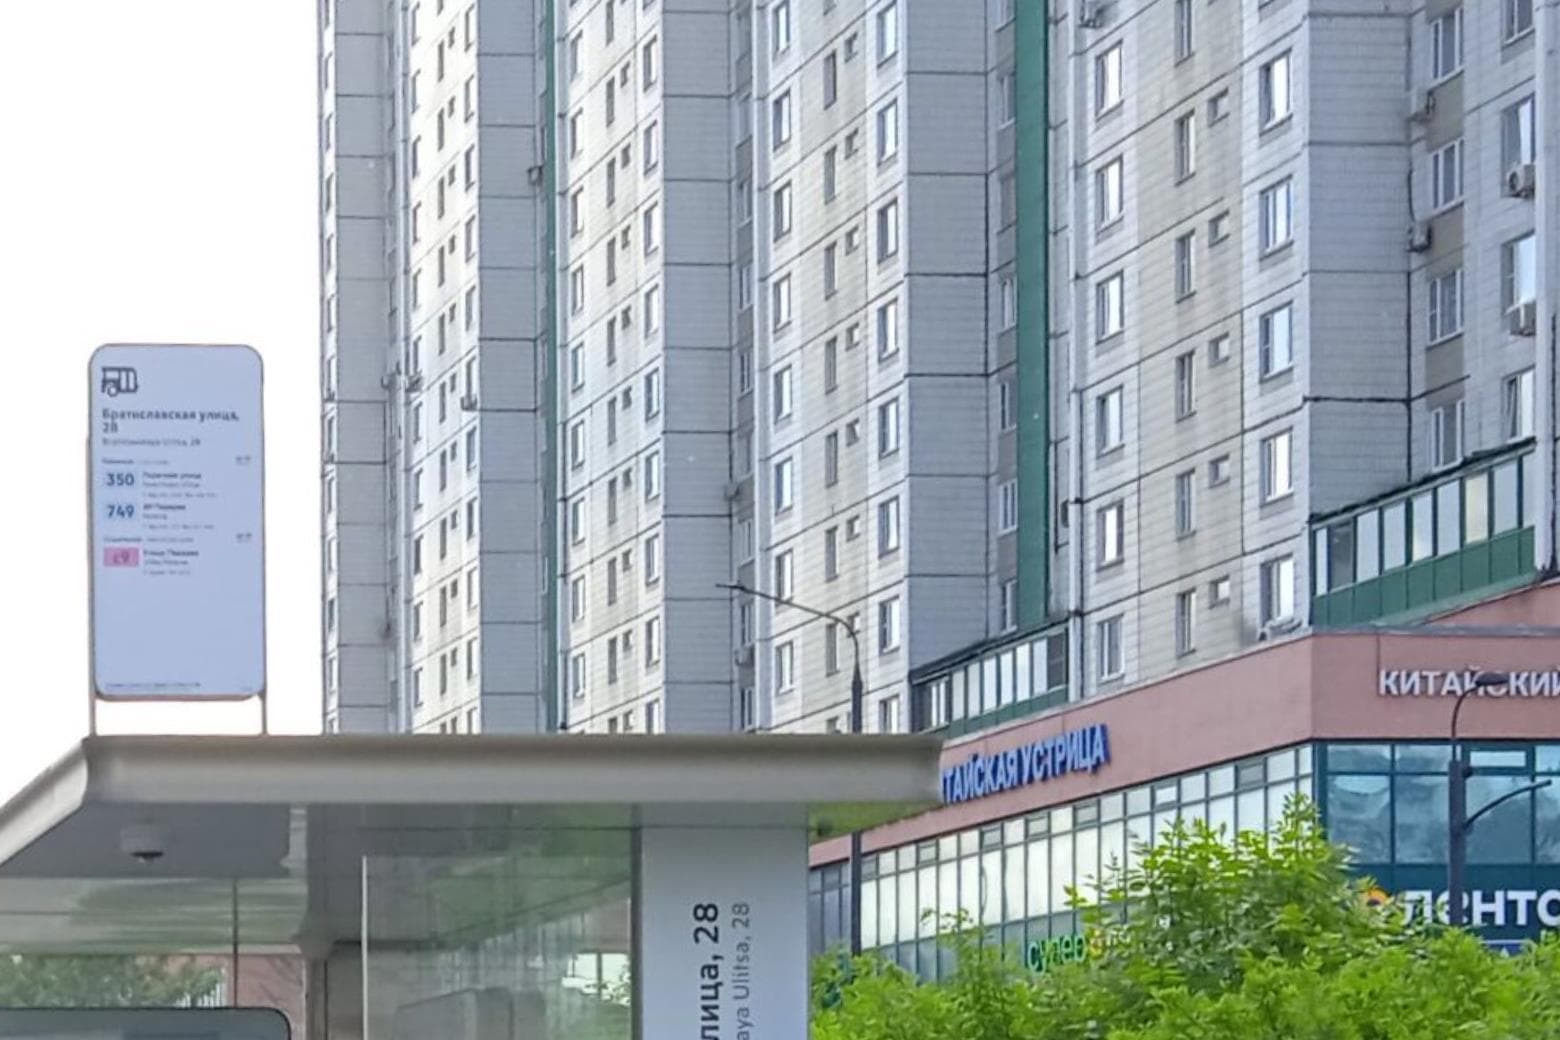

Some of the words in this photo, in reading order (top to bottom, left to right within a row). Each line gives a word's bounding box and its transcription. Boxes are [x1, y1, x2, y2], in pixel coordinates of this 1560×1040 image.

[106, 473, 135, 487] 350
[107, 504, 135, 518] 749
[1020, 724, 1111, 785] УСТРИЦА
[693, 902, 719, 945] 28
[732, 902, 751, 932] 28
[732, 936, 754, 1000] Ulitsa,
